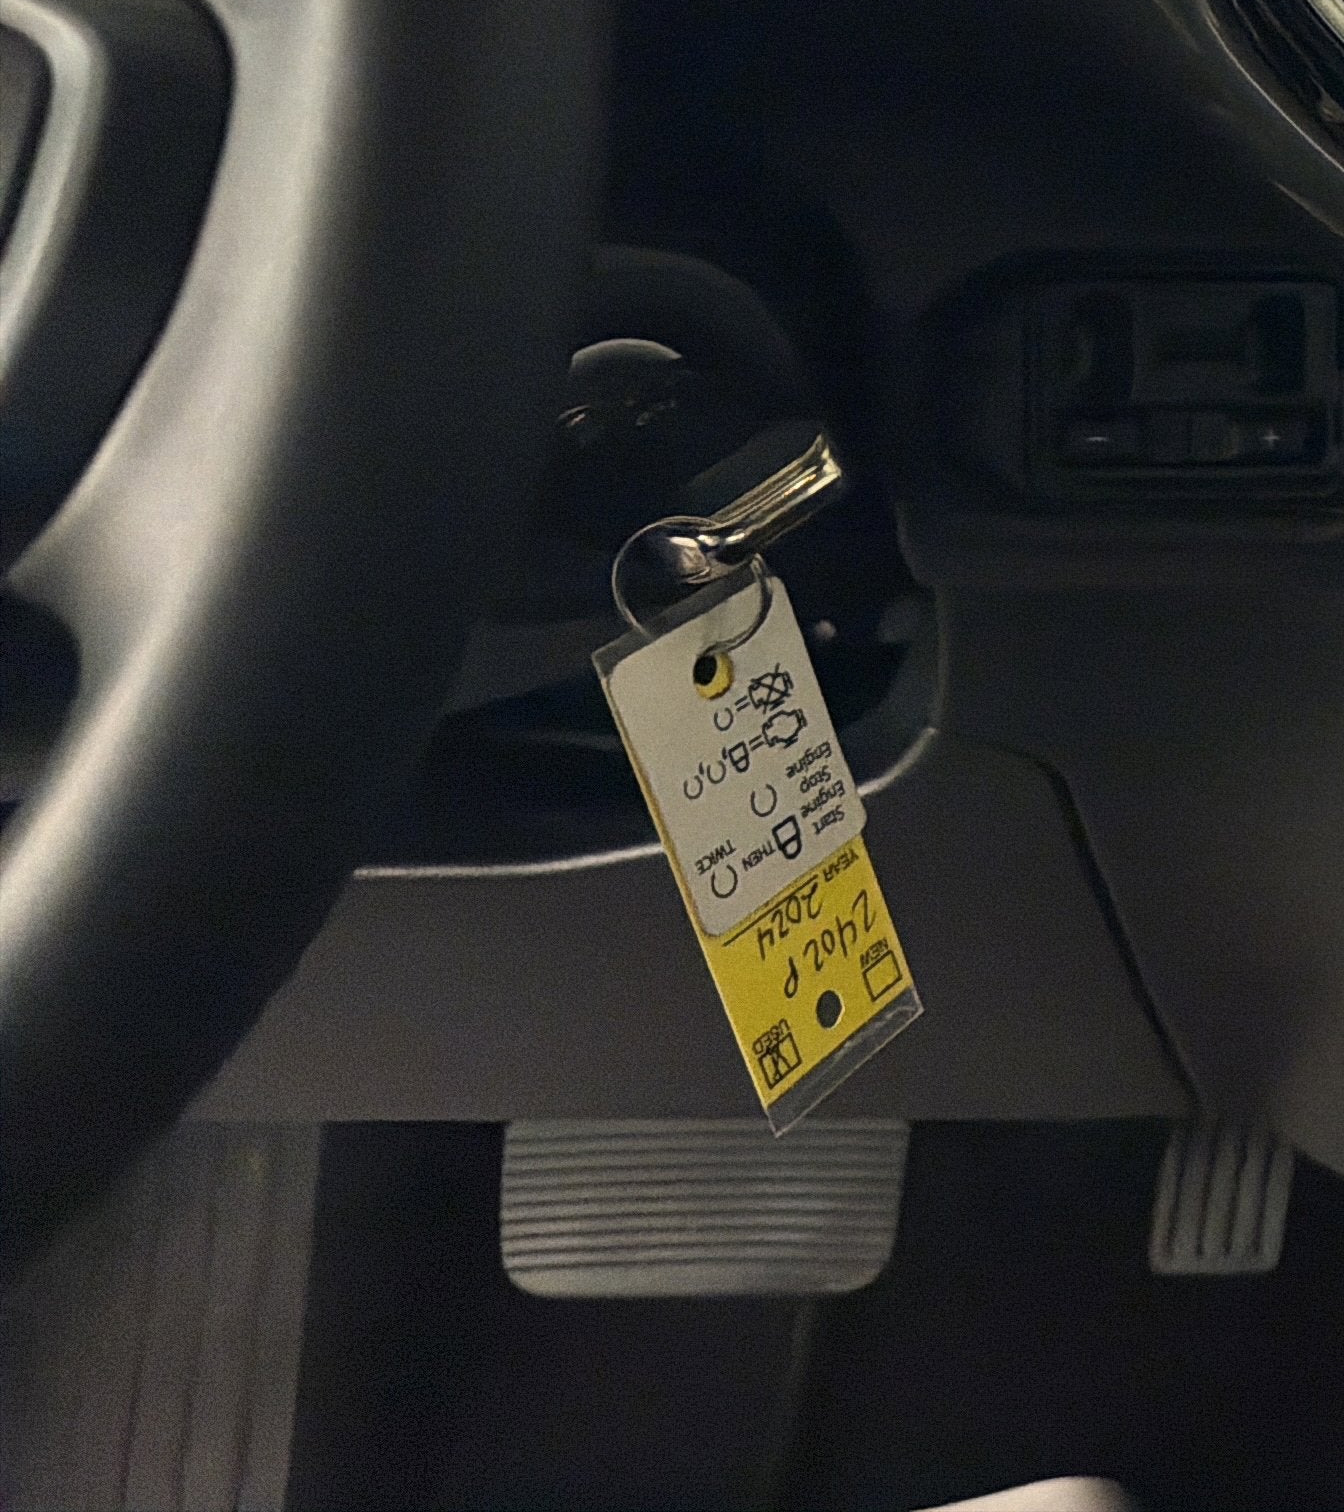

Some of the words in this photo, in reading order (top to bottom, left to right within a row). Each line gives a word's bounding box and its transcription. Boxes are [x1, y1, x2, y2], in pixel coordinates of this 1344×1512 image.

[785, 741, 832, 779] Engine
[799, 765, 832, 794] Stop
[800, 779, 846, 818] Engine
[812, 804, 846, 835] Start
[694, 839, 737, 875] TWICE
[741, 840, 775, 871] THEN
[823, 848, 860, 882] YEAR
[860, 939, 889, 969] NEW
